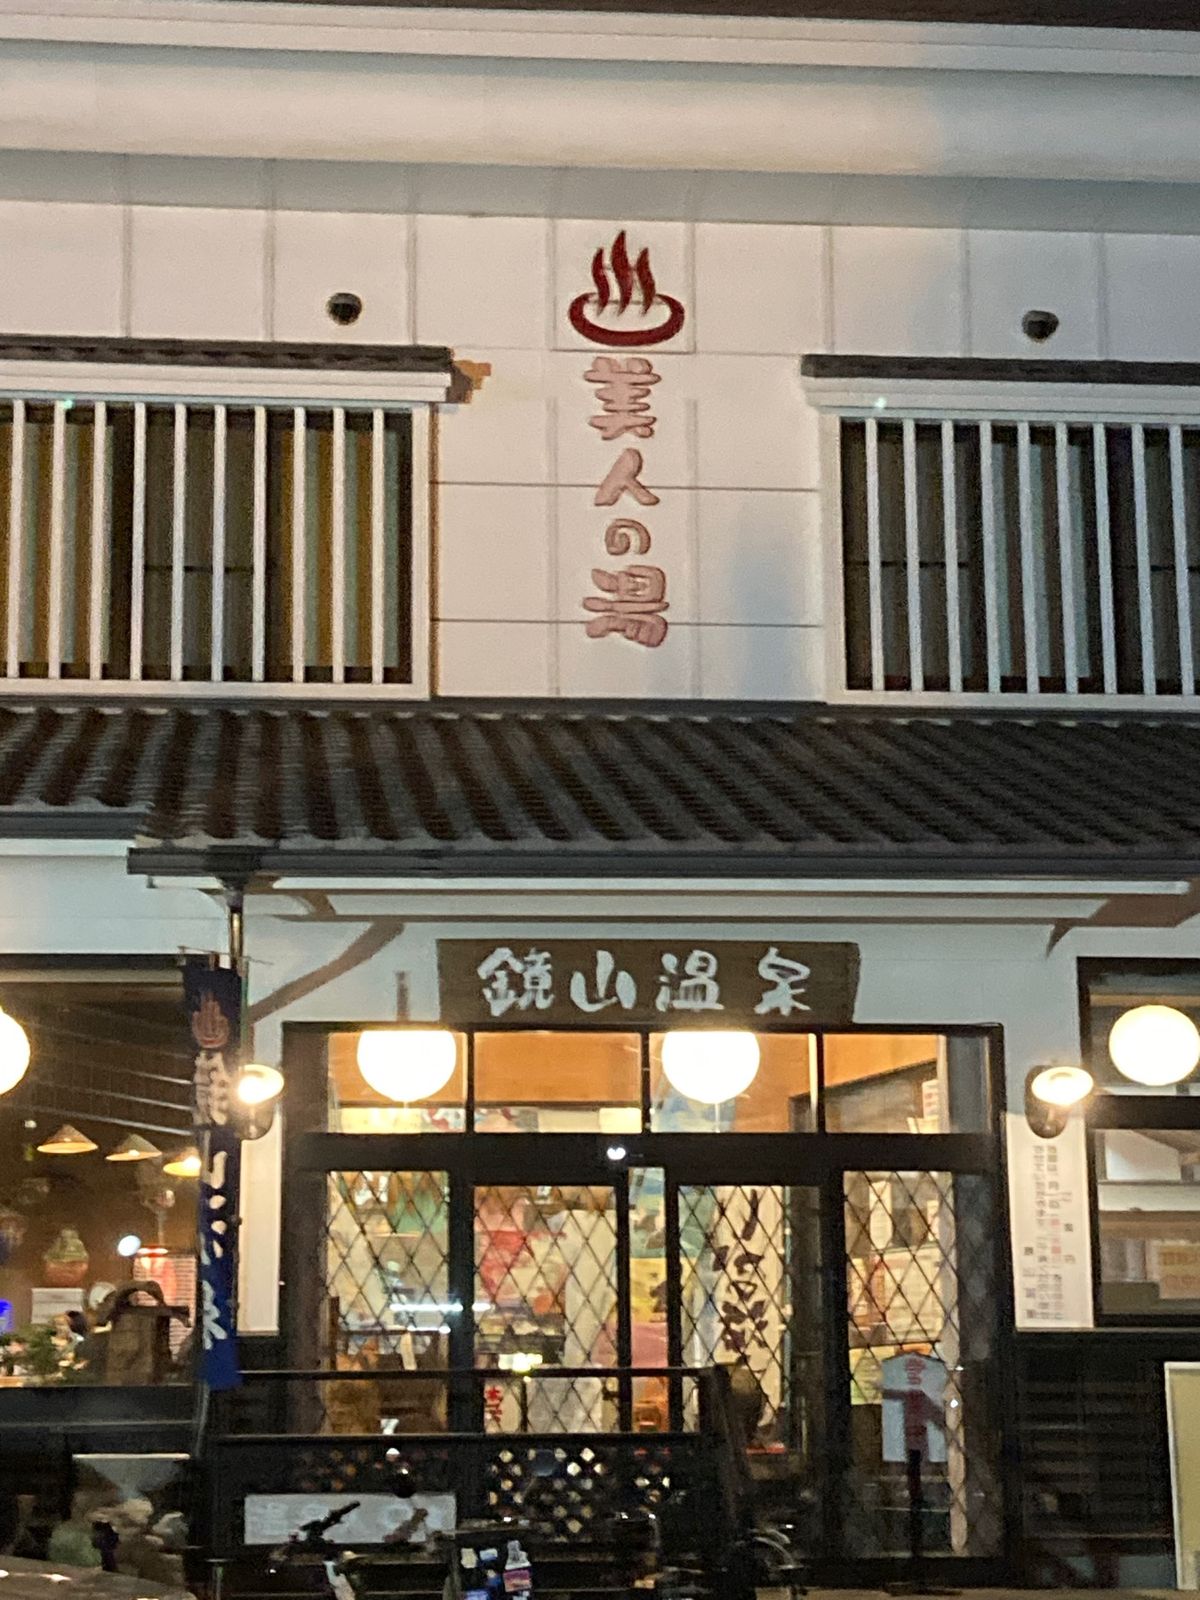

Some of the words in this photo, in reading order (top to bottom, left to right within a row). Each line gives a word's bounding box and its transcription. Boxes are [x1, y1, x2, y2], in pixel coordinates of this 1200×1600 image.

[582, 356, 670, 648] 美人の湯
[476, 946, 812, 1017] 鏡山温泉
